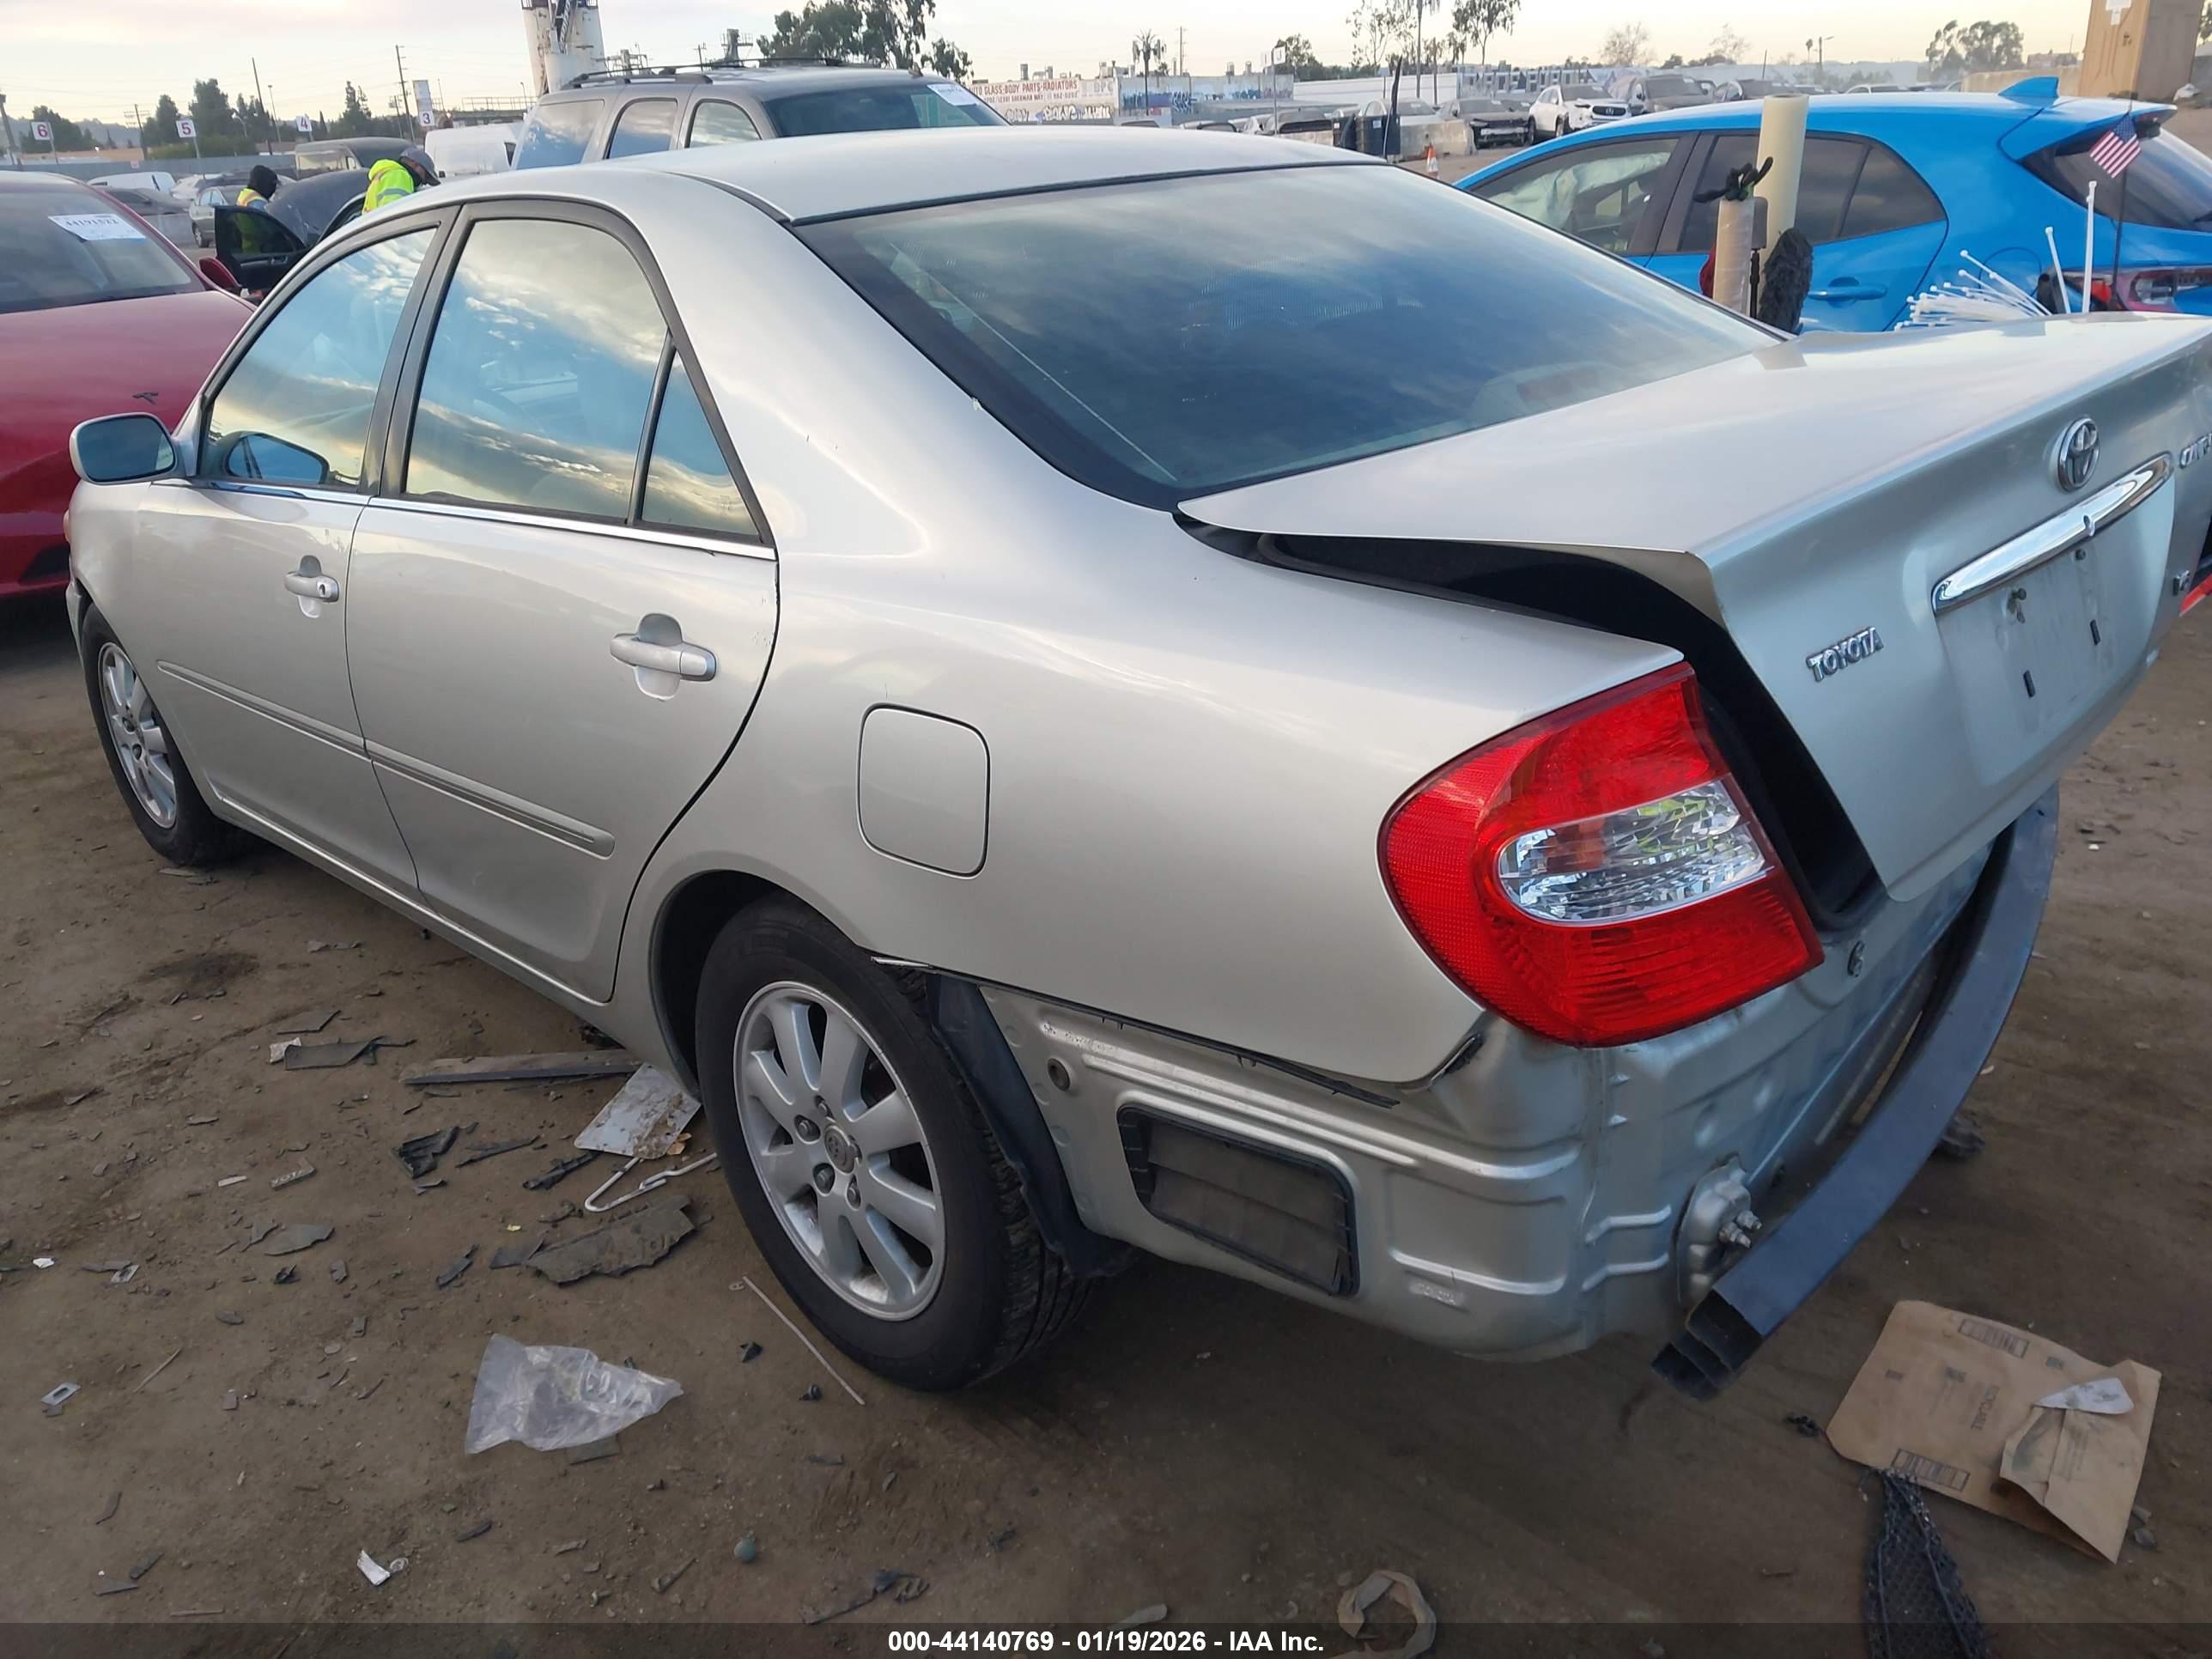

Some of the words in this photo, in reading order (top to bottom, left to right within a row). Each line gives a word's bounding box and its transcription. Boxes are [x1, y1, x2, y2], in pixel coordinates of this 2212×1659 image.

[301, 118, 308, 130] 4
[422, 112, 431, 125] 3
[37, 125, 48, 137] 6
[181, 122, 191, 135] 5
[1805, 625, 1884, 682] TOYOTA
